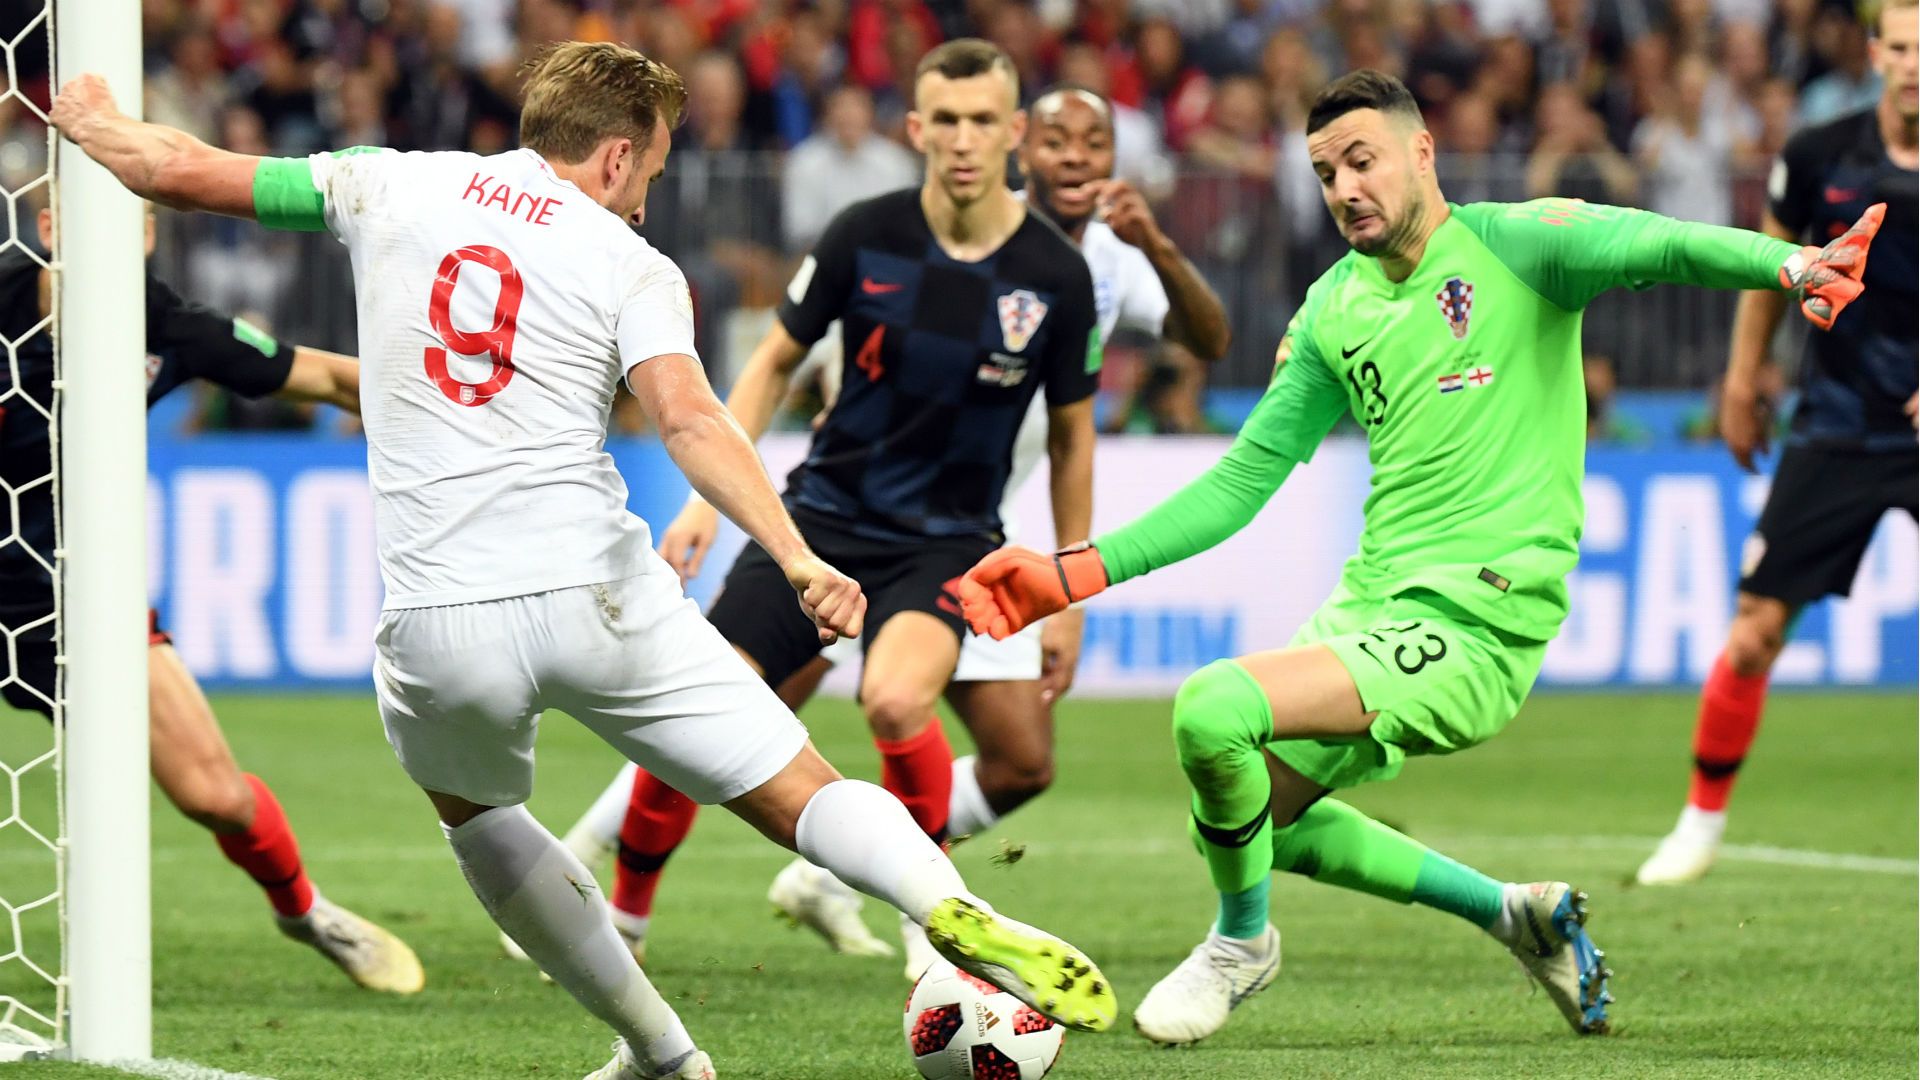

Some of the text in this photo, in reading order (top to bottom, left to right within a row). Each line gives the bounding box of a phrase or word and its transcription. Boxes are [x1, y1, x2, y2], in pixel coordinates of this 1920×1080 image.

[462, 172, 563, 226] KANE
[424, 244, 524, 407] 9
[856, 323, 887, 382] 4
[147, 468, 386, 676] RO
[975, 1002, 986, 1038] adidas
